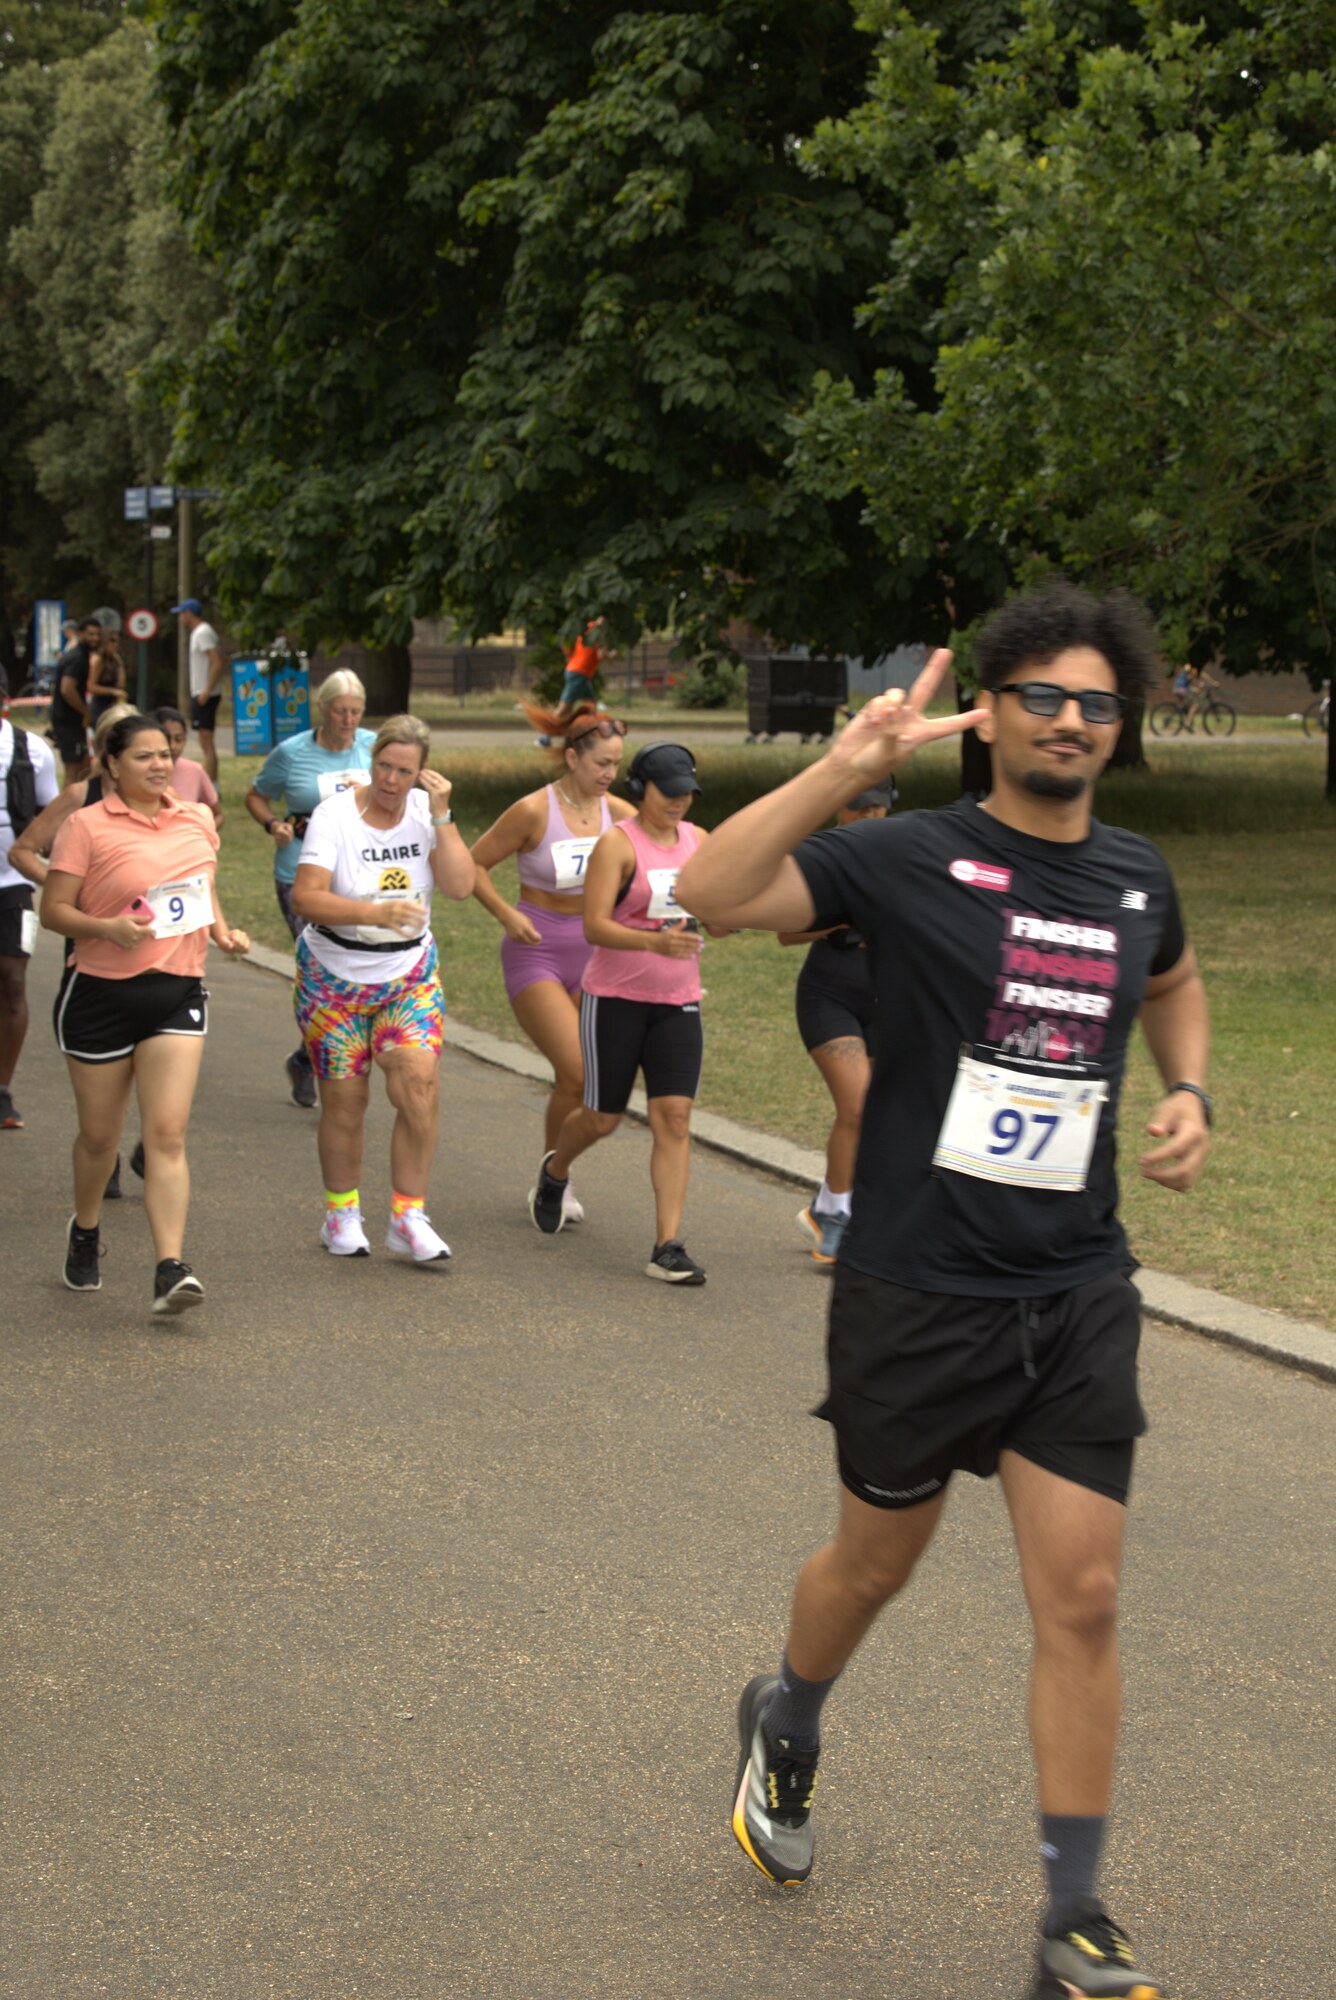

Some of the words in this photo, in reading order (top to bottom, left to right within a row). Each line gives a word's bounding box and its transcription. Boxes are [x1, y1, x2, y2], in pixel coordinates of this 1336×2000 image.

[362, 843, 421, 862] CLAIRE
[571, 854, 590, 875] 7
[168, 896, 185, 922] 9
[1011, 915, 1118, 952] FINISHER
[1009, 948, 1119, 985] FINISHER
[1002, 981, 1113, 1018] FINISHER
[986, 1108, 1063, 1162] 97
